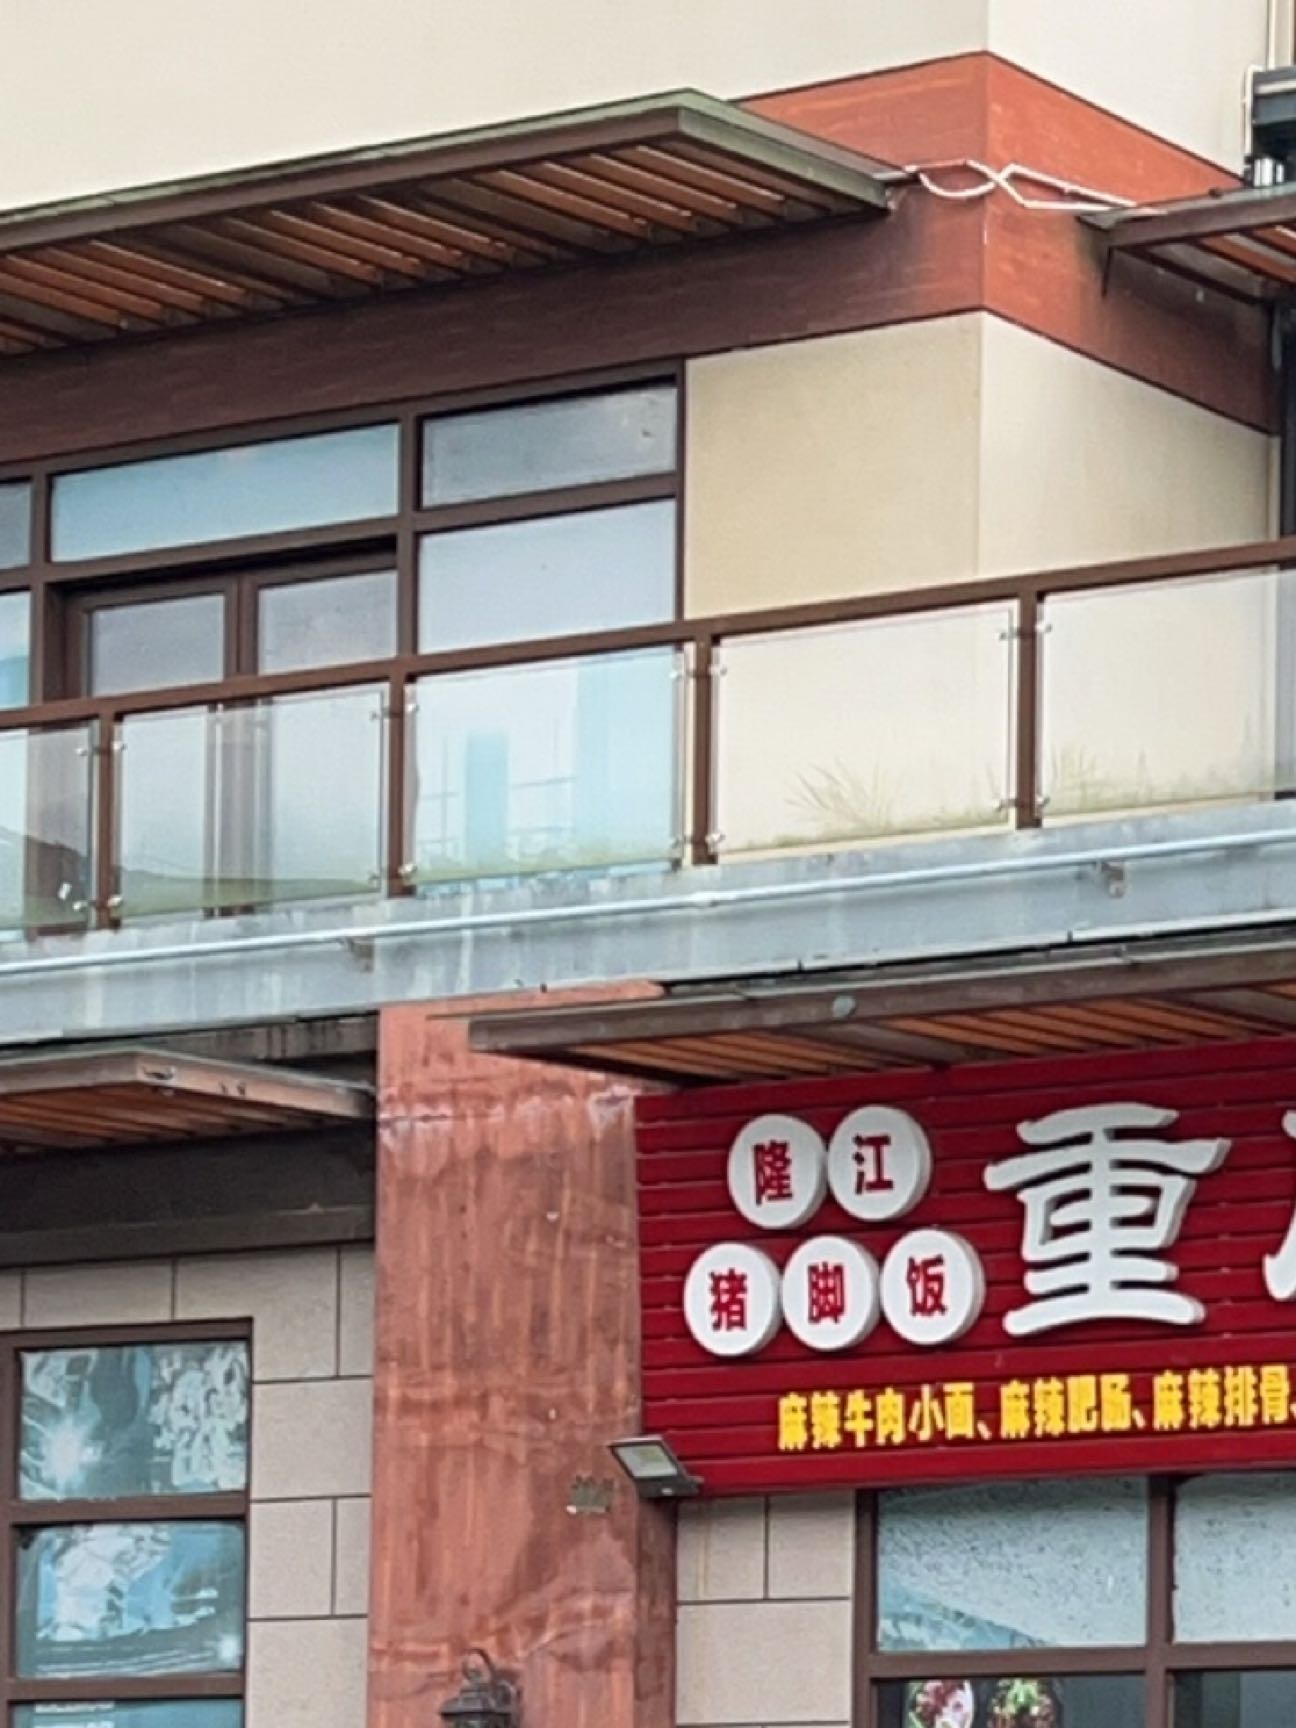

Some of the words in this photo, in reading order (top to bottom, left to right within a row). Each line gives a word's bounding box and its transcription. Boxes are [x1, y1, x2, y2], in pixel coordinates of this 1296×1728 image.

[753, 1134, 894, 1207] 隆江
[708, 1253, 947, 1332] 猪脚饭
